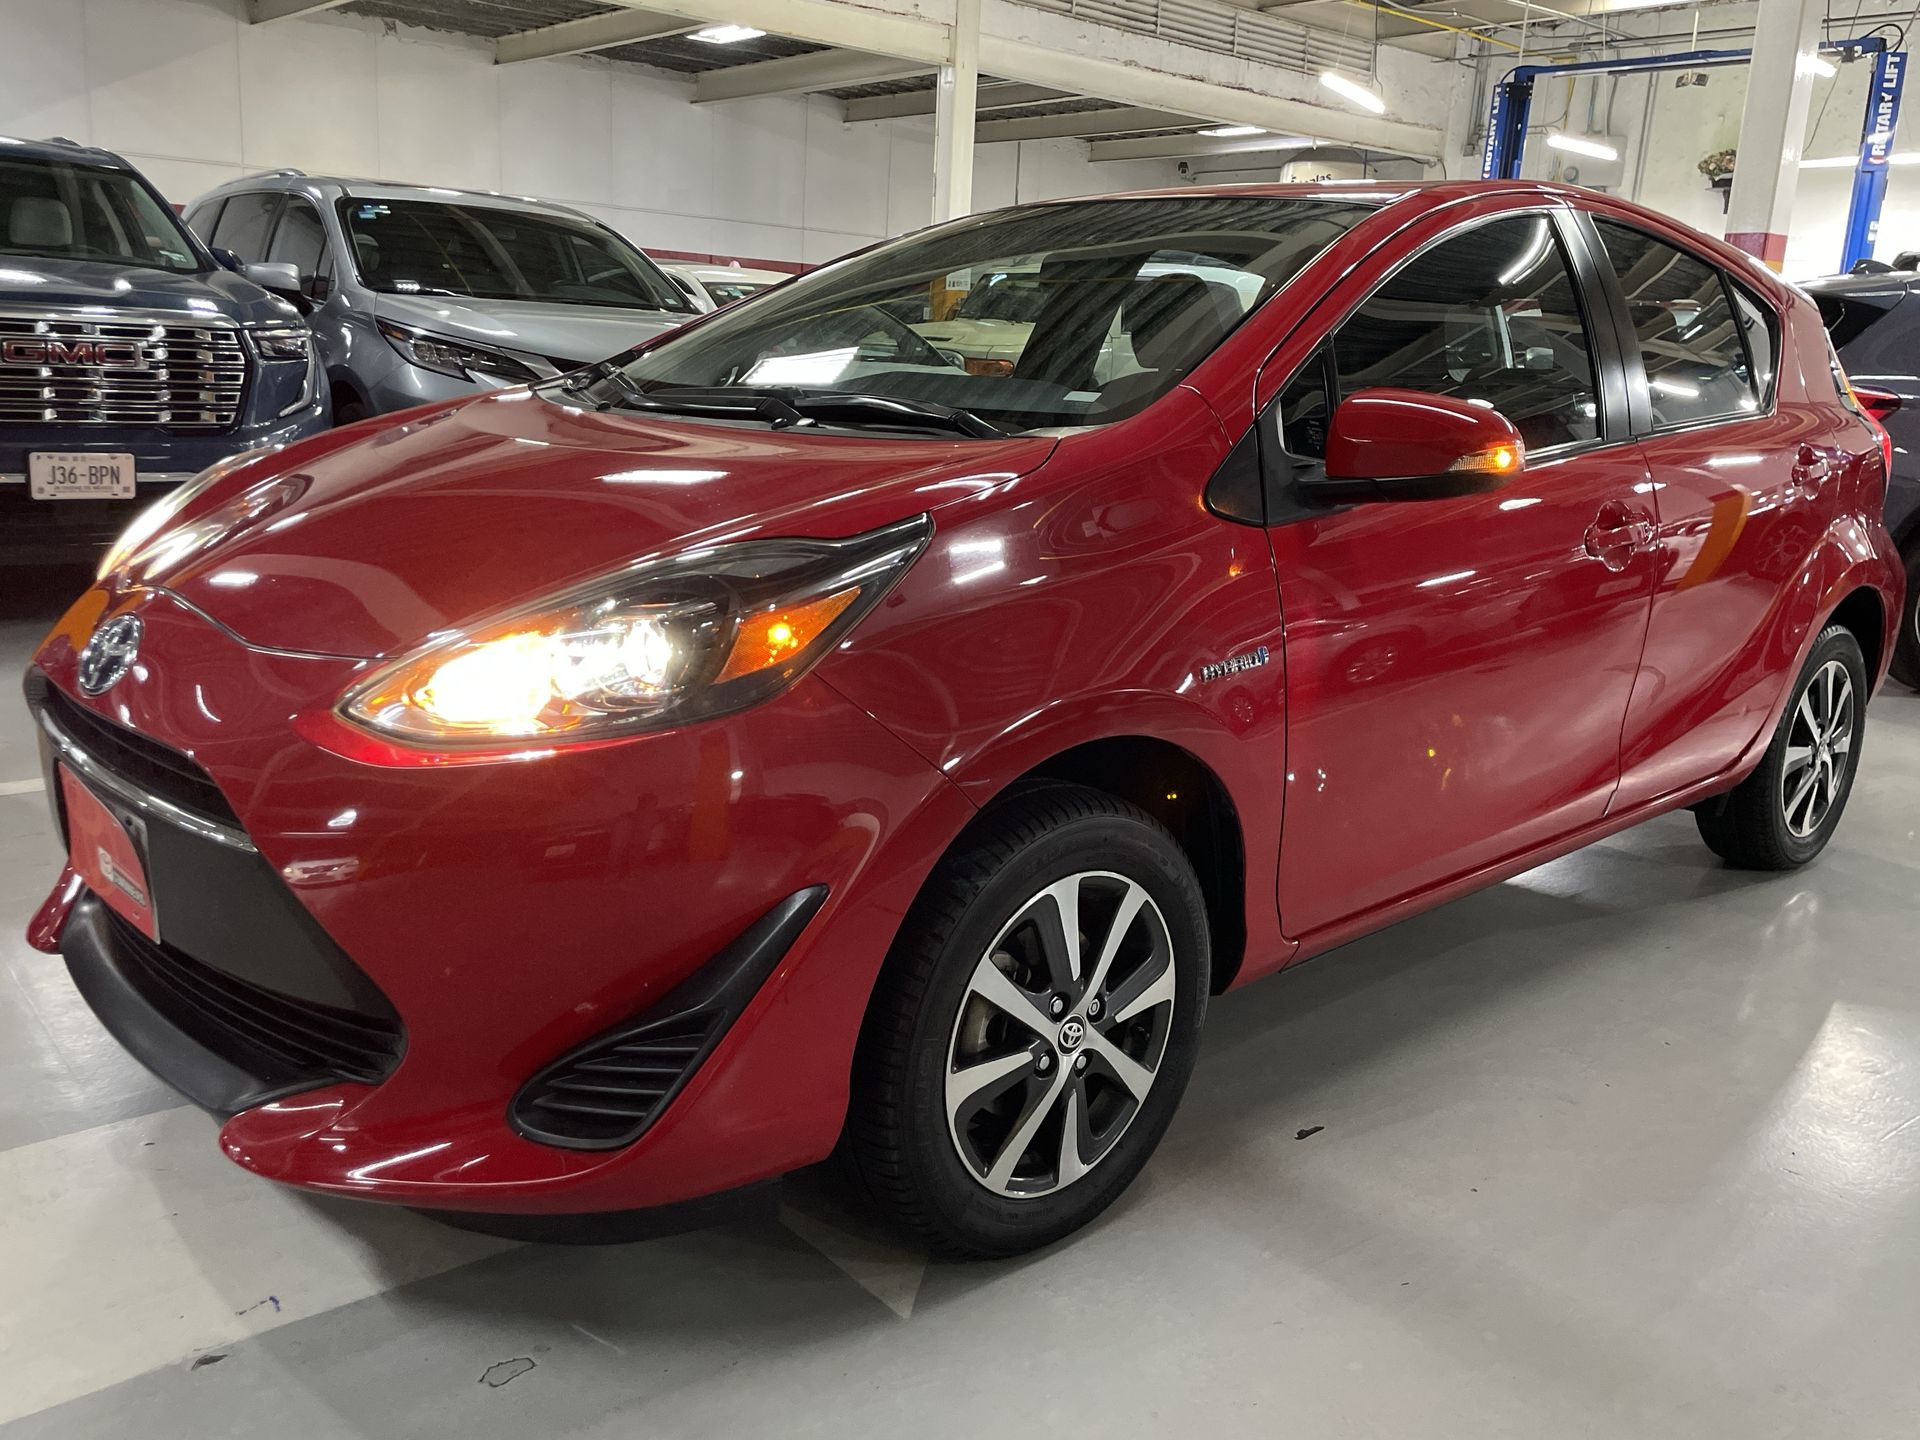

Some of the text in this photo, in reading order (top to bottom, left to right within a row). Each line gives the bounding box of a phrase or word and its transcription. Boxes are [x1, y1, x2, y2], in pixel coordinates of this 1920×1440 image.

[1883, 54, 1901, 88] LIFT
[3, 340, 138, 367] GMC
[46, 465, 120, 485] J36-BPN
[1200, 653, 1261, 683] HYBRID
